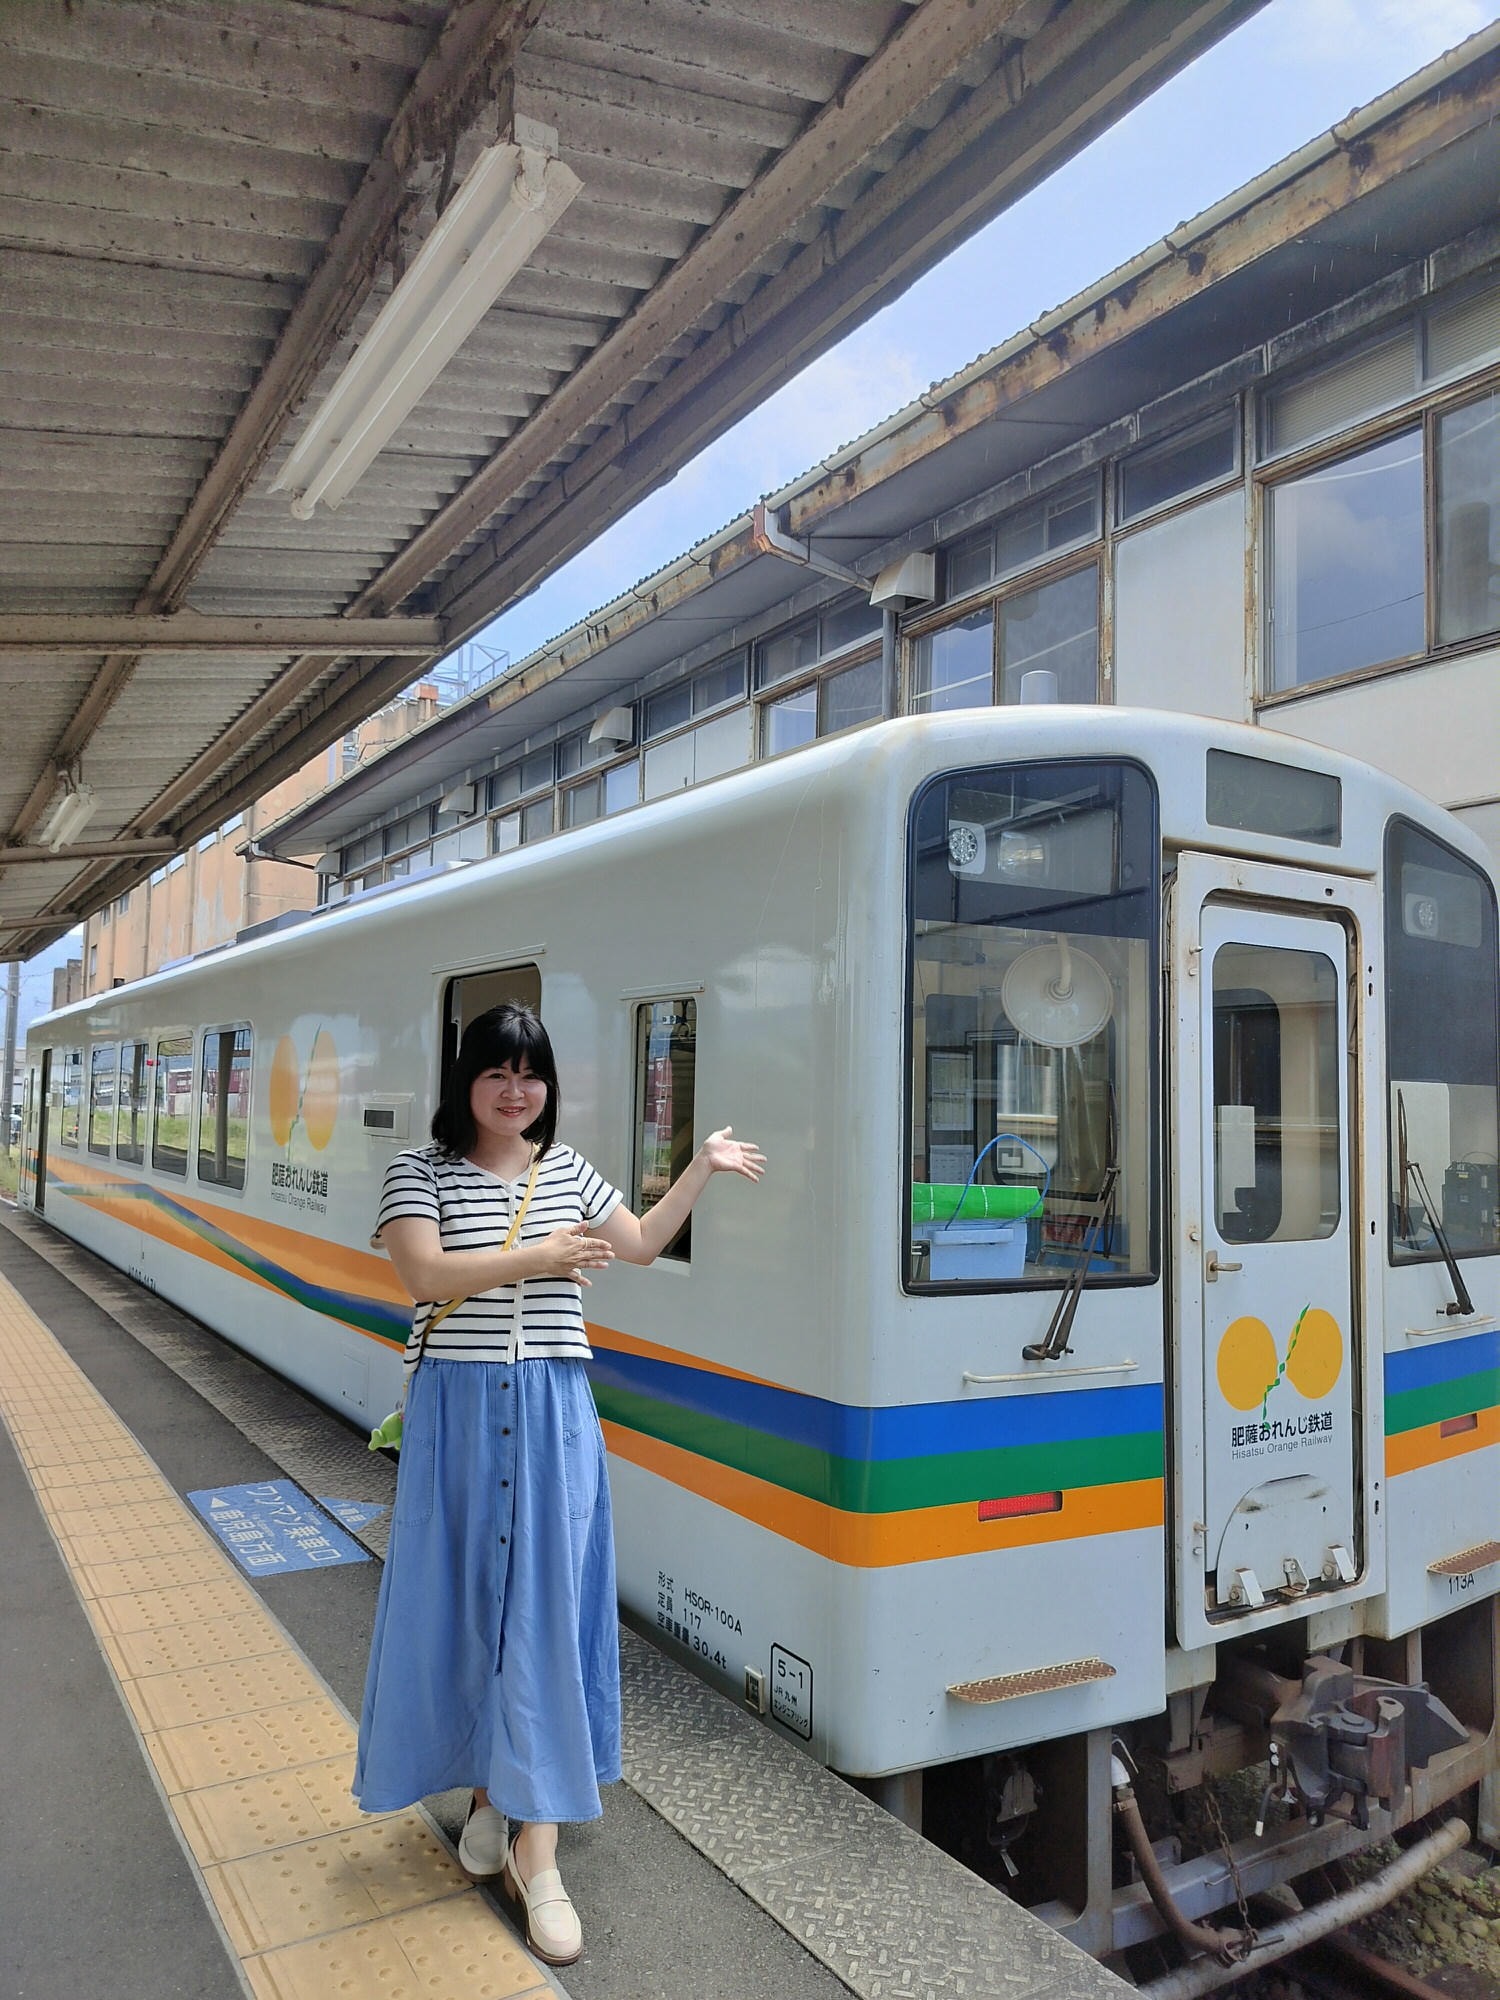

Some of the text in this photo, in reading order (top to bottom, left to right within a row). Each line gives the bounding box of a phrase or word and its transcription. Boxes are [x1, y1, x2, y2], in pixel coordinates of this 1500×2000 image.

[1231, 1411, 1333, 1448] 肥薩おれんじ鉄道
[1232, 1433, 1333, 1460] Hisatsu Orange Railway
[209, 1509, 287, 1566] 鹿児島方面
[246, 1485, 342, 1562] ワンマン乗車口
[1449, 1573, 1474, 1595] 113A
[683, 1608, 701, 1631] 117
[693, 1636, 727, 1670] 30.4t
[777, 1658, 803, 1690] 5-1
